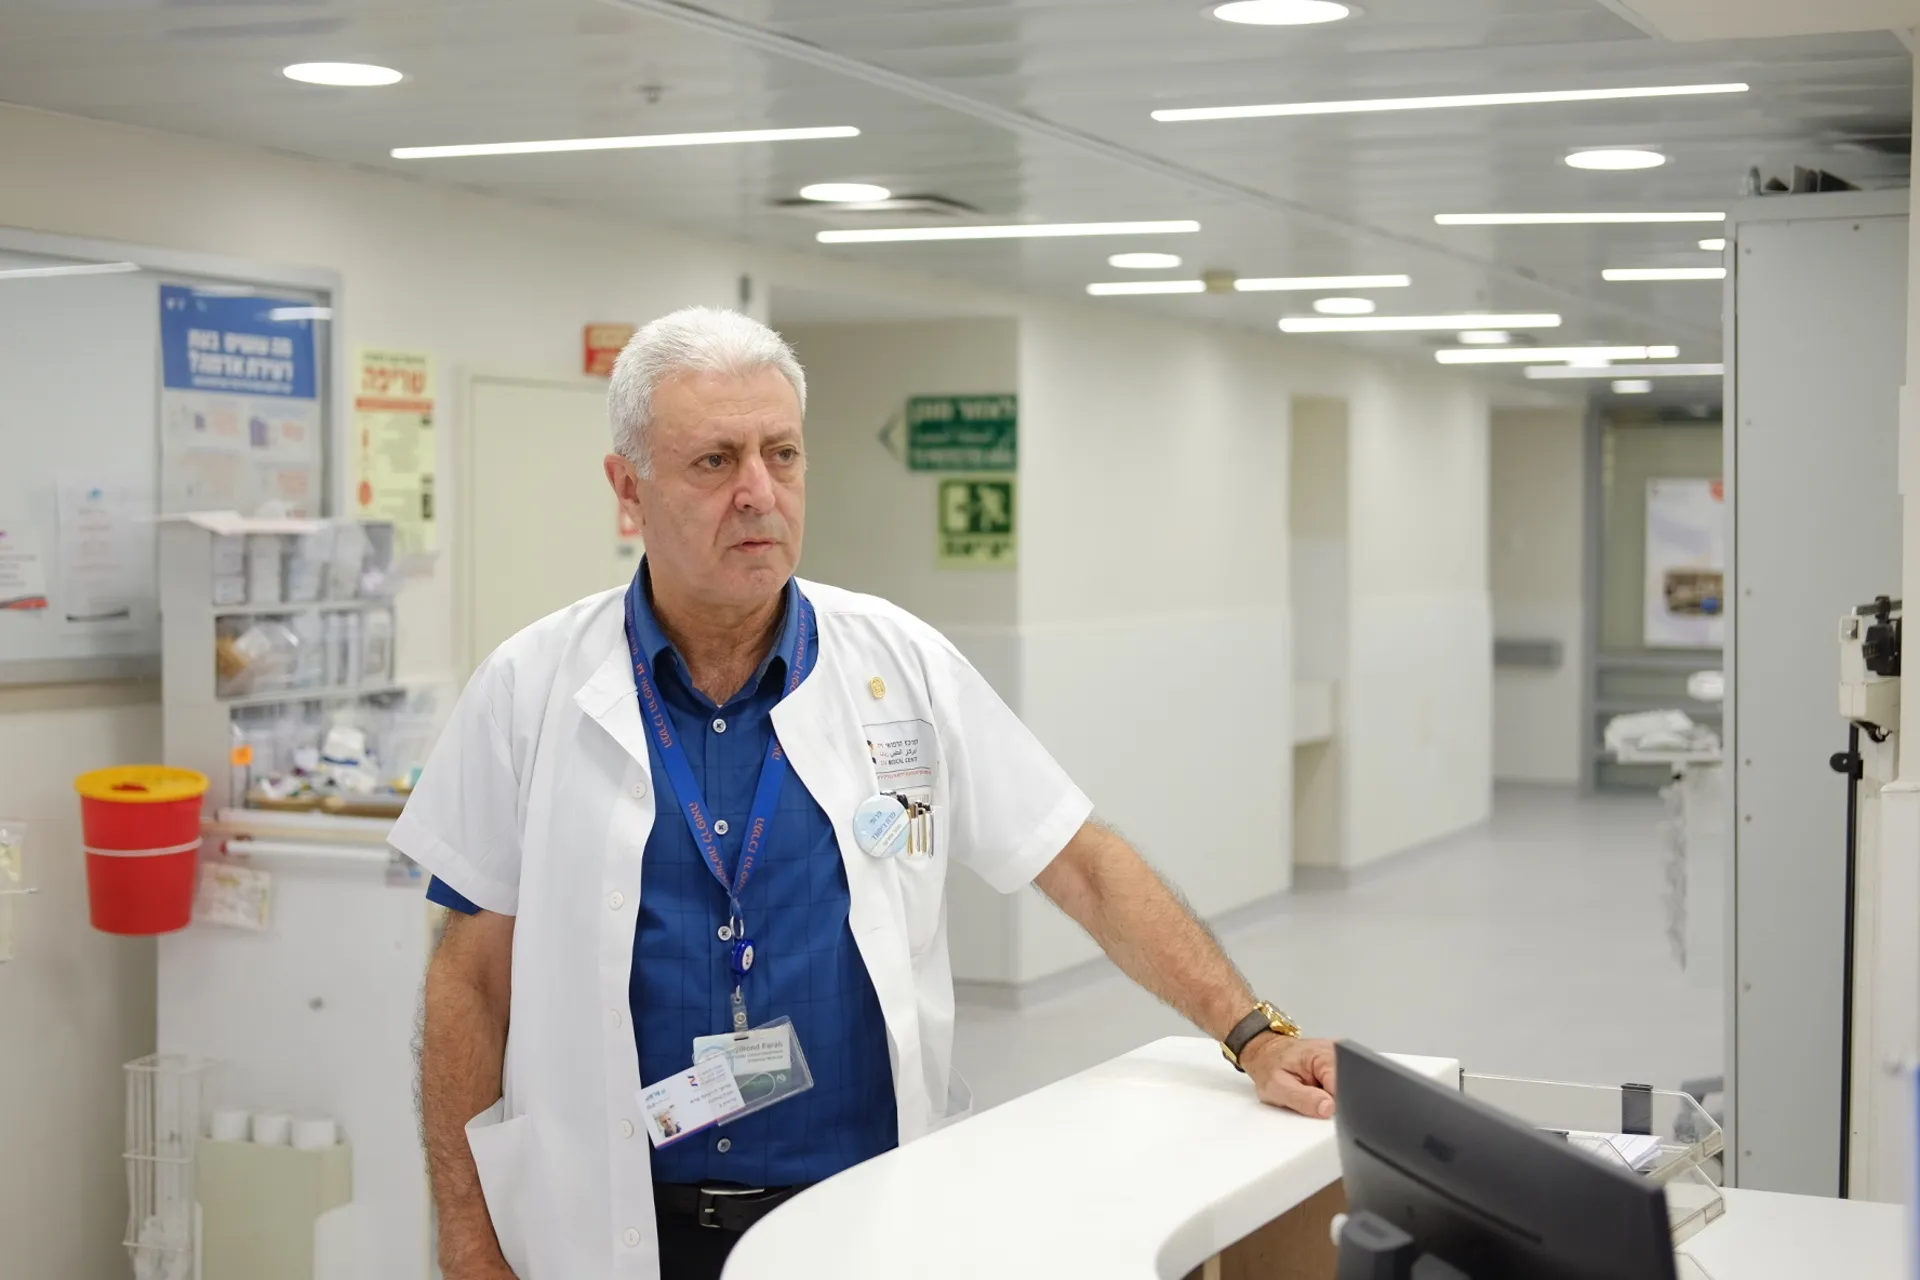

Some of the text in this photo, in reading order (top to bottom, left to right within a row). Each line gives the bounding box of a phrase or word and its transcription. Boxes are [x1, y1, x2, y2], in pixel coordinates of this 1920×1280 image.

[362, 366, 427, 396] שריפה
[635, 662, 673, 749] המרכז הרפואי זיו
[688, 800, 714, 845] לרפואה
[747, 816, 765, 854] המרכז
